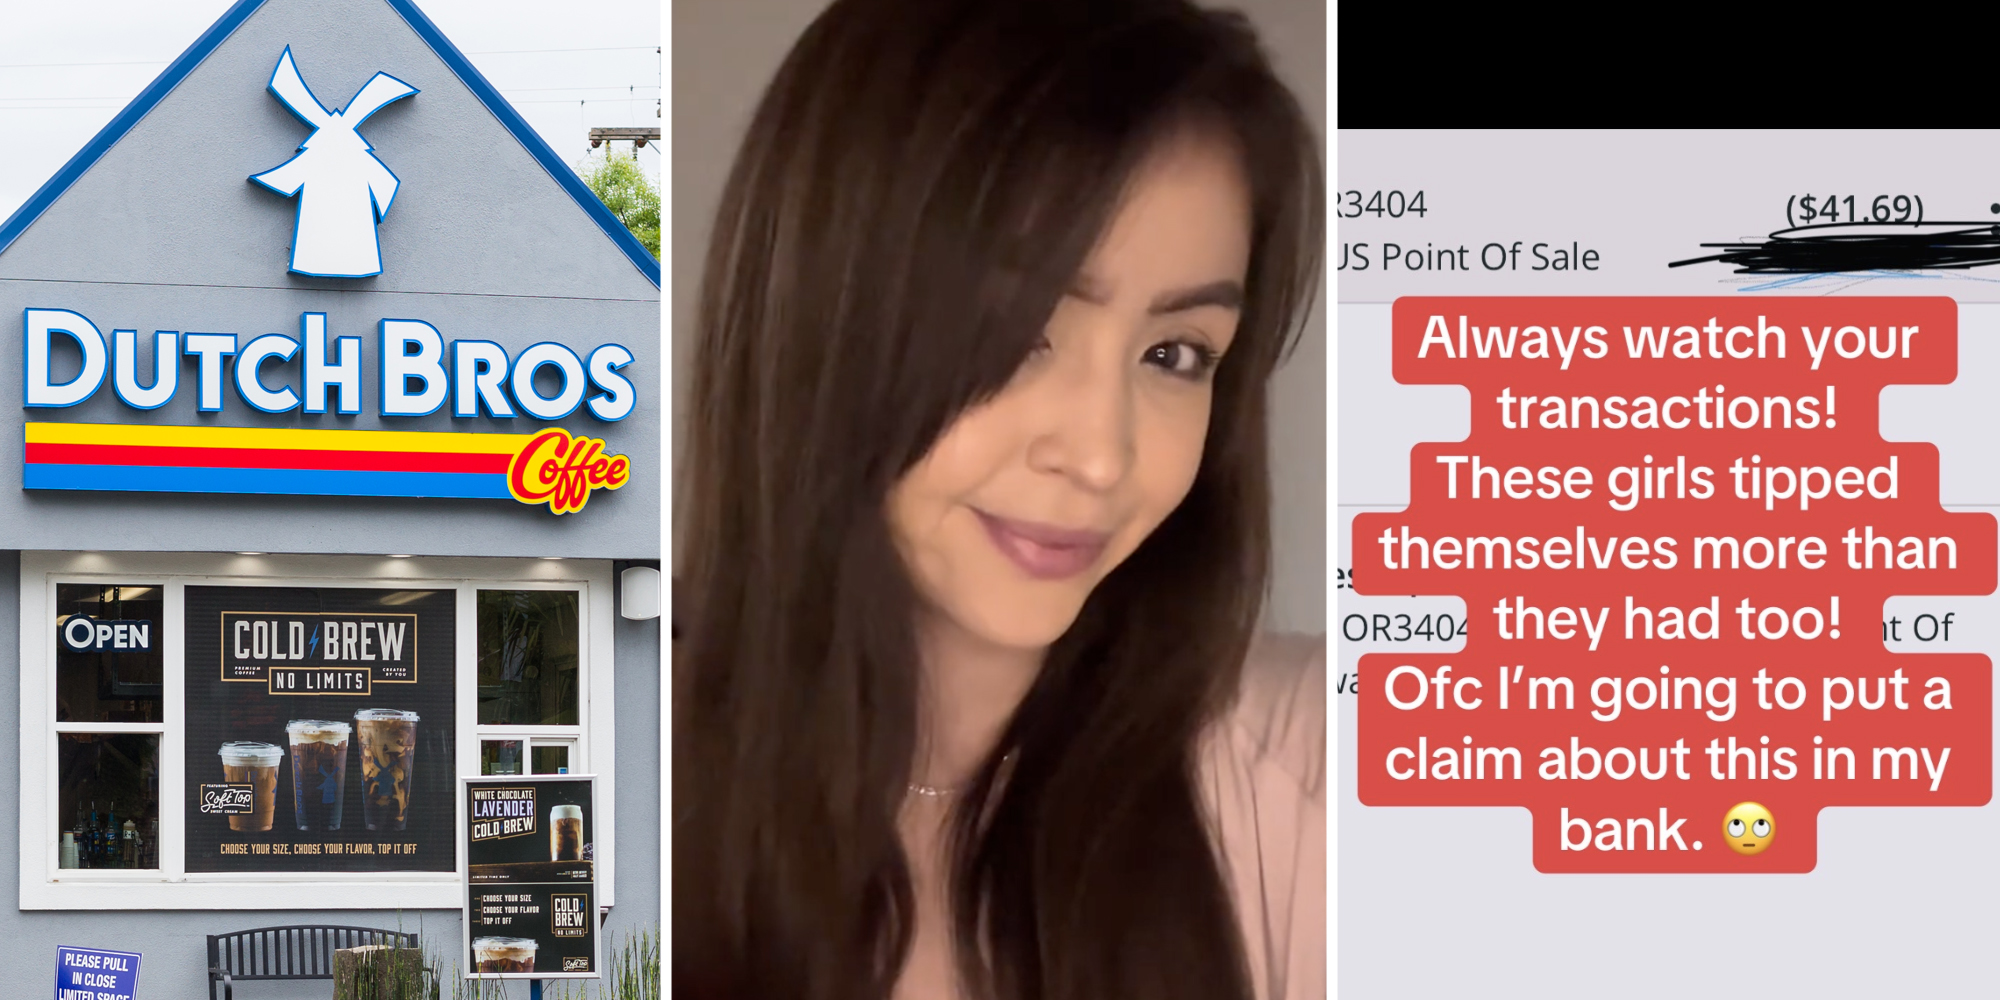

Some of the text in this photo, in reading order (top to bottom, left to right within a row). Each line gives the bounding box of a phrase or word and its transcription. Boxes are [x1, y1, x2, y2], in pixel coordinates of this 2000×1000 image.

[1337, 190, 1924, 227] 3404 ($41.69)
[1383, 242, 1470, 271] Point
[1481, 241, 1523, 271] Of
[1531, 241, 1600, 271] Sale
[378, 318, 637, 422] BROS
[511, 431, 626, 510] Coffee
[65, 618, 148, 648] OPEN
[1913, 612, 1955, 642] Of
[234, 620, 406, 660] COLD BREW
[276, 672, 363, 689] NO LIMITS
[201, 789, 236, 812] Soft
[234, 790, 252, 804] Top
[474, 790, 533, 800] WHITE CHOCOLATE
[474, 800, 533, 817] LAVENDER
[474, 816, 533, 838] COLD BREW
[220, 844, 417, 855] CHOOSE YOUR SIZE, CHOOSE YOUR FLAVOR, TOP IT OFF
[554, 898, 579, 912] COLD
[555, 912, 584, 926] BREW
[65, 953, 128, 972] PLEASE PULL
[72, 972, 116, 988] IN CLOSE
[59, 988, 94, 1000] LIMITED
